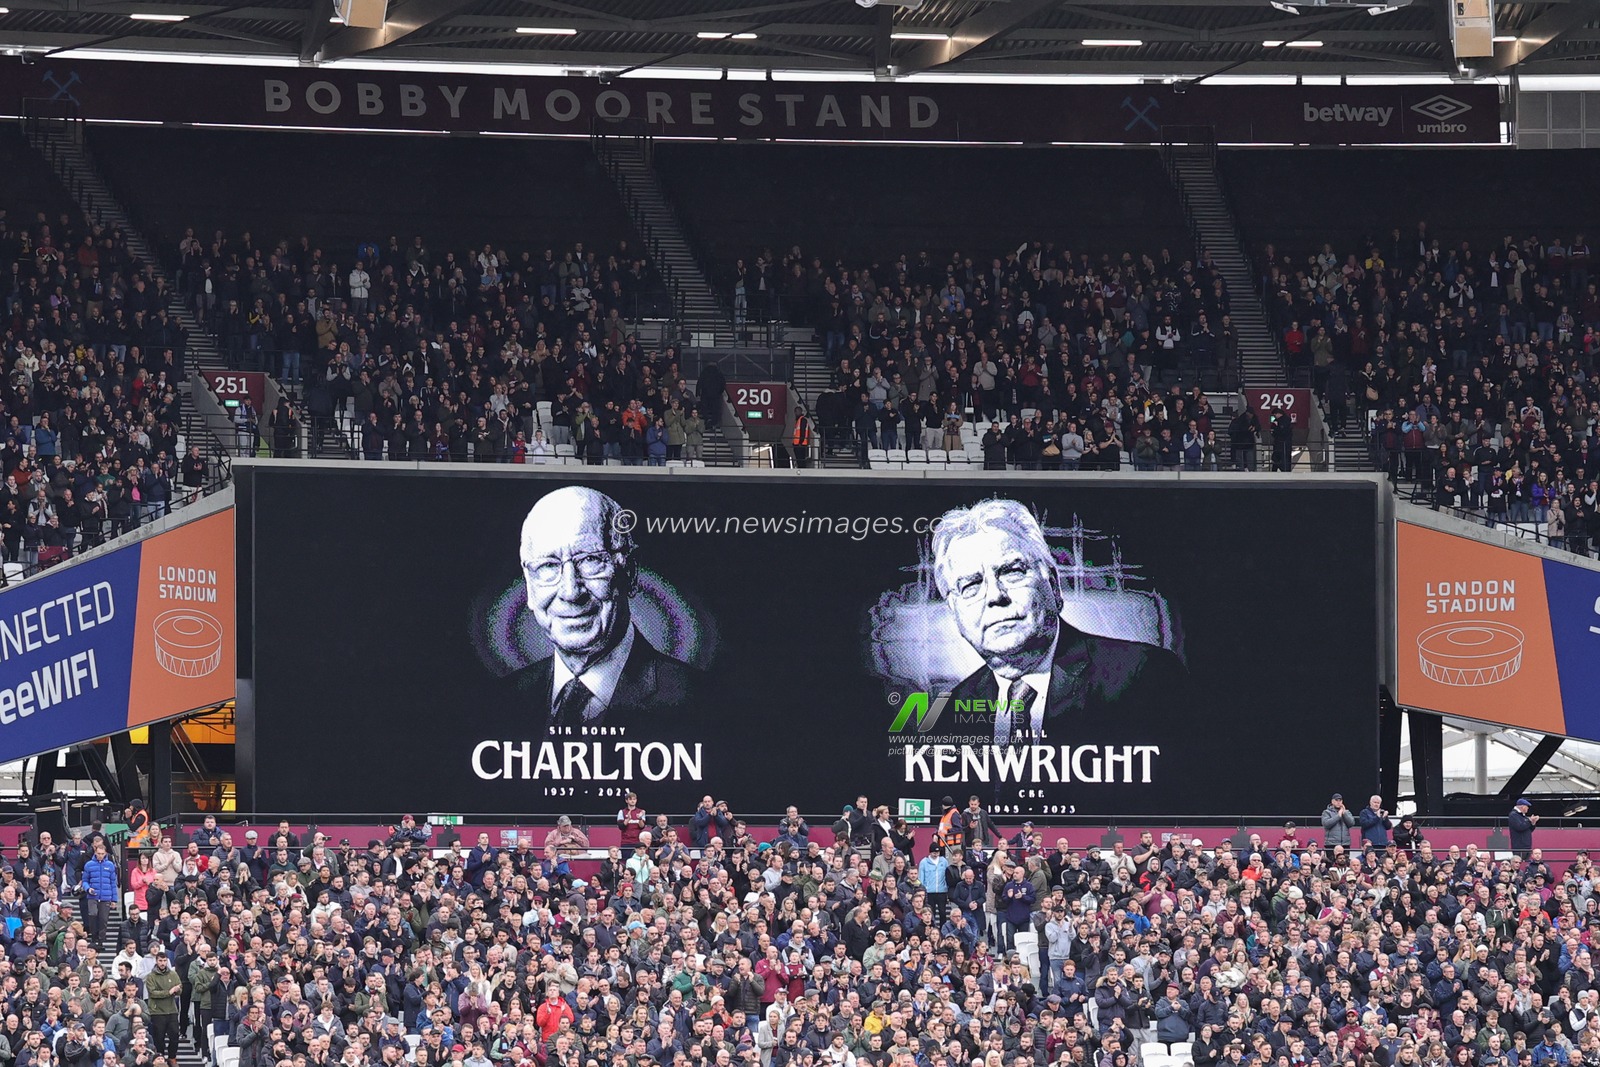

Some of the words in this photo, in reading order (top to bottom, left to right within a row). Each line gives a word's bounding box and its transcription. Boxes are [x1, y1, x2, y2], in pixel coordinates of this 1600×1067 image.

[264, 79, 468, 118] BOBBY
[493, 87, 715, 125] MOORE
[738, 92, 940, 128] STAND
[1303, 102, 1393, 127] betway
[1417, 122, 1467, 133] umbro
[215, 376, 249, 394] 251
[737, 388, 772, 406] 250
[1260, 393, 1295, 410] 249
[159, 565, 217, 585] LONDON
[159, 583, 217, 603] STADIUM
[1426, 579, 1515, 597] LONDON
[1426, 597, 1515, 614] STADIUM
[0, 581, 115, 663] NECTED
[549, 726, 572, 735] SIR
[581, 726, 626, 736] BOBBY
[1016, 729, 1047, 738] BILL
[471, 740, 703, 782] CHARLTON
[904, 744, 1161, 783] KENWRIGHT
[544, 787, 575, 797] 1937
[987, 804, 1020, 814] 1945
[1043, 804, 1076, 814] 2023
